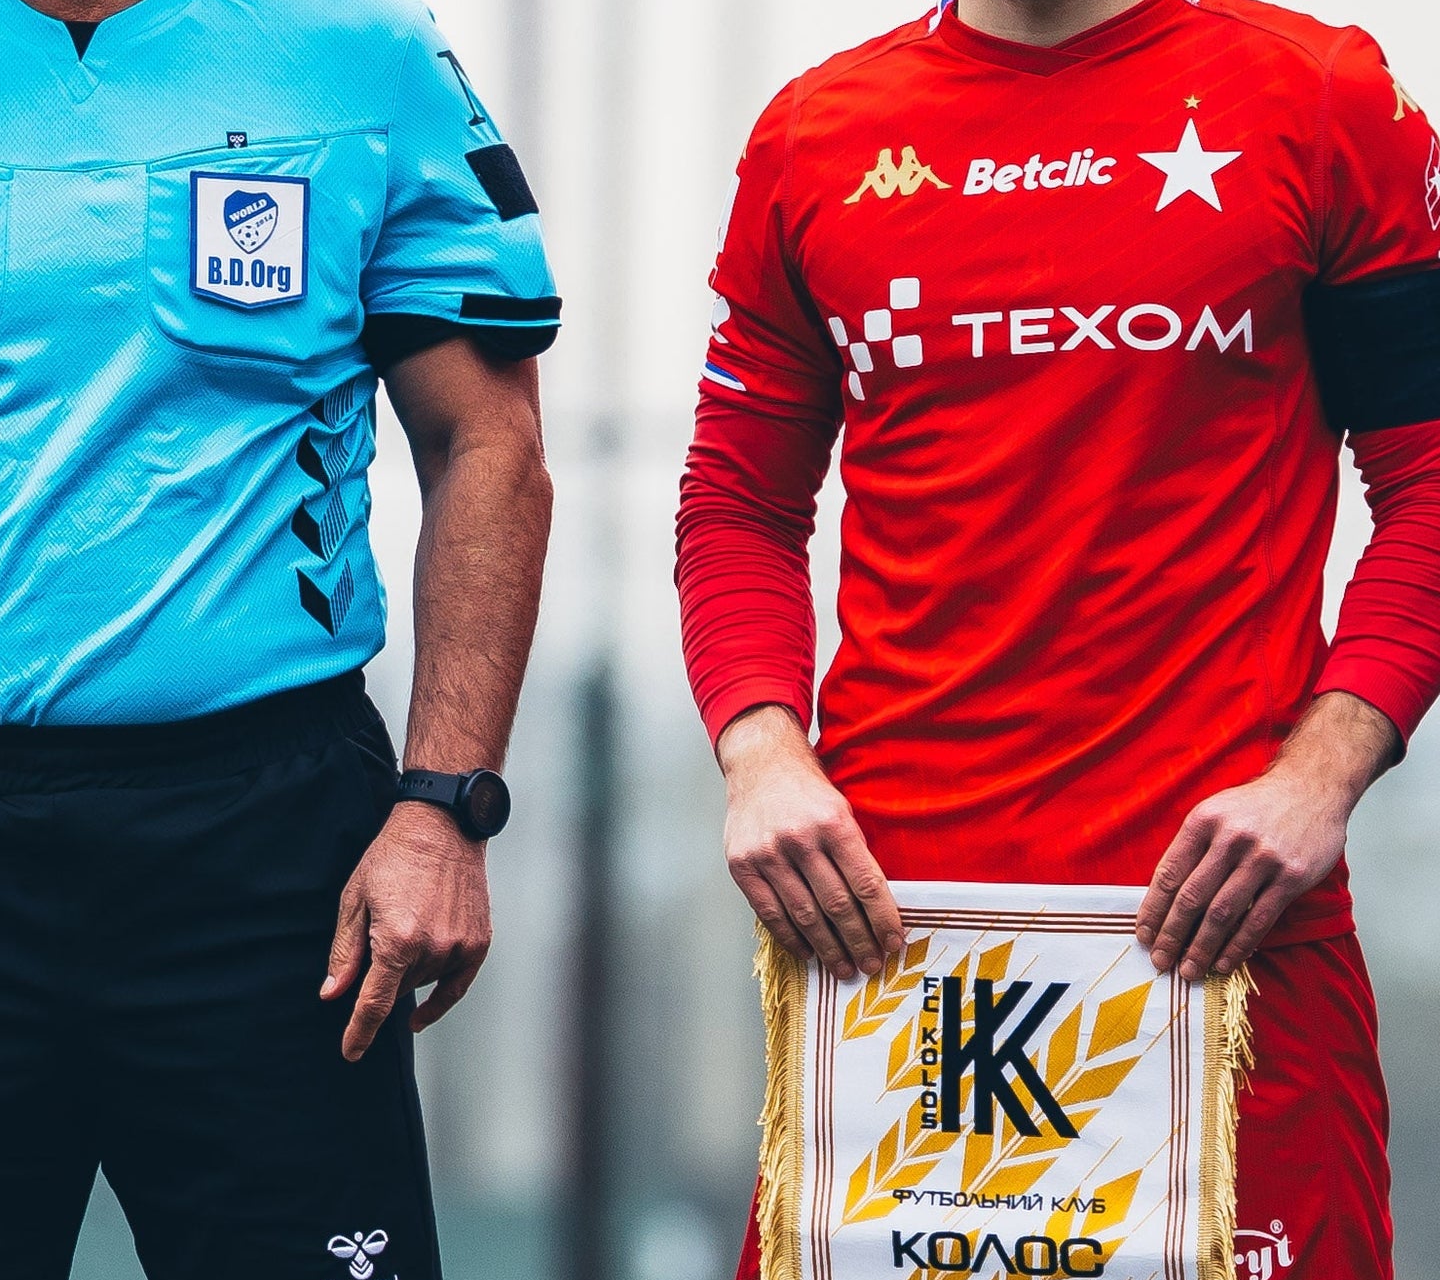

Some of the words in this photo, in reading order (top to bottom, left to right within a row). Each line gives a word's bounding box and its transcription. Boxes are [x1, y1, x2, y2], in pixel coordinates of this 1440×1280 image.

[962, 147, 1118, 196] Betclic
[229, 198, 268, 222] WORLD
[207, 256, 291, 293] B.D.Org
[951, 303, 1254, 358] TEXOM
[923, 977, 940, 1013] FC
[920, 1027, 939, 1130] KOLOS
[892, 1189, 1043, 1211] ФУТБОЛЬНИЙ
[1051, 1196, 1107, 1214] КЛУБ
[891, 1230, 1105, 1278] КОЛОС
